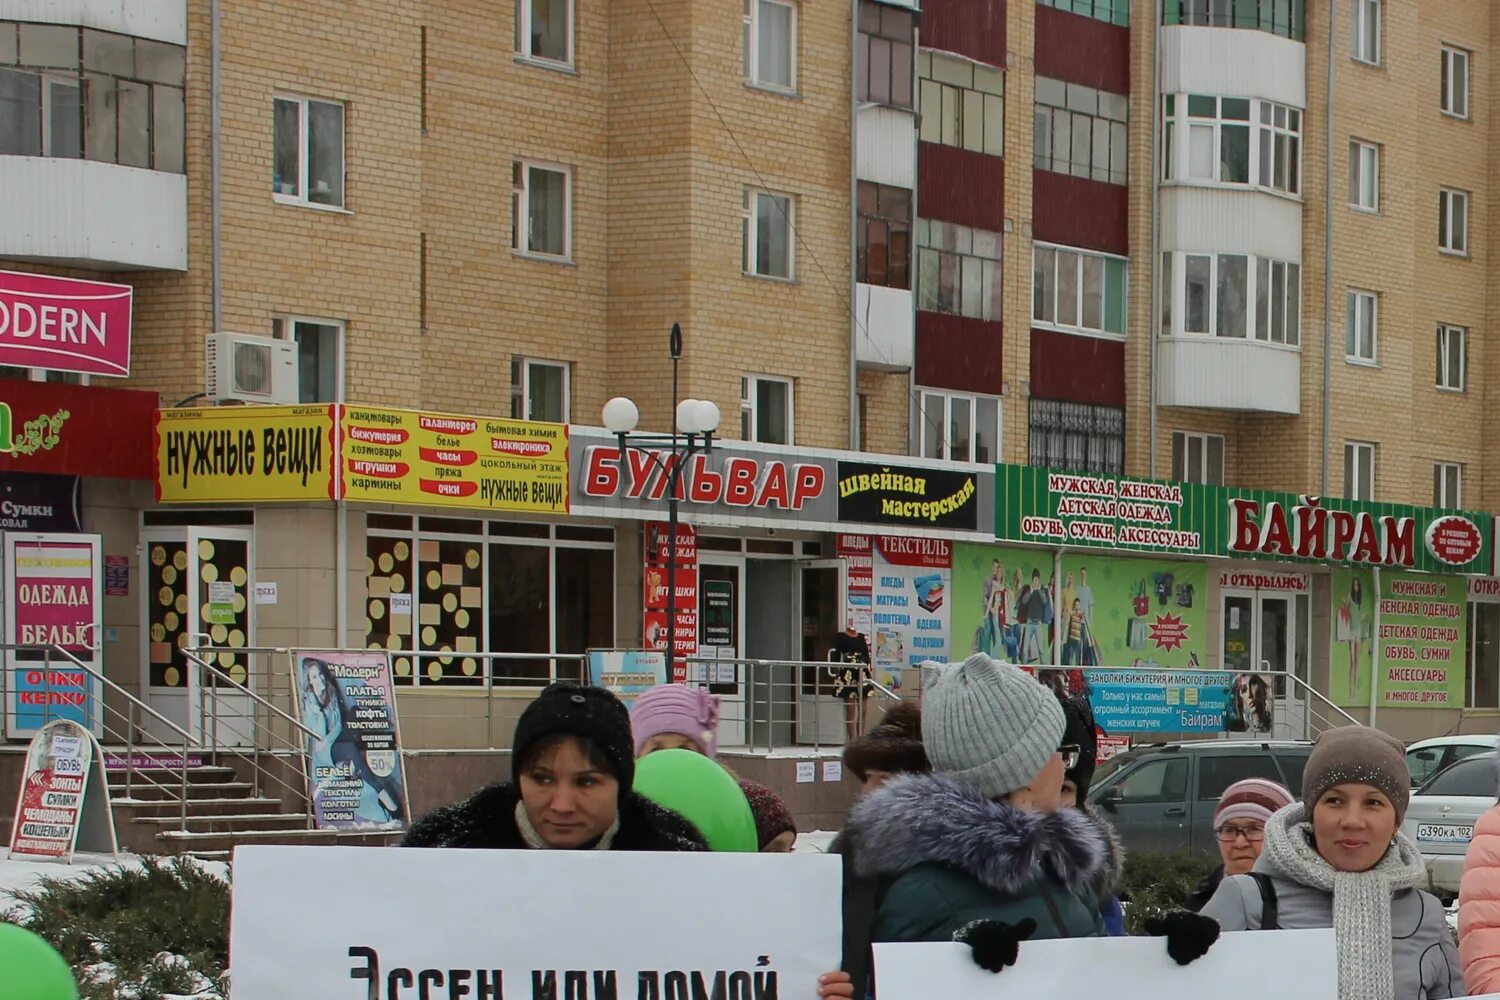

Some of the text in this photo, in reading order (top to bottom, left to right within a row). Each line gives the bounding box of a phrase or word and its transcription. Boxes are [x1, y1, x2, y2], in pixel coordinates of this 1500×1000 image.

[350, 410, 402, 424] канцтовары
[421, 417, 476, 432] галантерея
[486, 423, 557, 438] бытовая химия
[351, 428, 401, 443] бижутерия
[436, 435, 460, 447] белье
[351, 445, 402, 458] хозтовары
[493, 439, 551, 453] электроника
[167, 426, 322, 489] нужные вещи
[436, 452, 461, 462] часы
[355, 462, 397, 474] игрушки
[481, 459, 561, 472] цокольный этаж
[435, 467, 462, 478] пряжа
[582, 445, 825, 511] БУЛЬВАР
[352, 478, 401, 490] картины
[438, 484, 460, 494] очки
[1049, 474, 1183, 505] МУЖСКАЯ, ЖЕНСКАЯ,
[481, 478, 562, 509] нужные вещи
[1059, 498, 1171, 522] ДЕТСКАЯ ОДЕЖДА
[1023, 518, 1199, 548] ОБУВЬ, СУМКИ, АКСЕССУАРЫ
[1228, 495, 1415, 567] БАЙРАМ
[657, 534, 695, 545] МУСКАЯ
[881, 536, 948, 556] ТЕКСТИЛЬ
[20, 585, 89, 605] ОДЕЖДА
[1392, 581, 1446, 596] МУЖСКАЯ И
[1423, 604, 1460, 618] ОДЕЖДА
[677, 615, 695, 624] ЧАСЫ
[22, 622, 88, 645] БЕЛЬЁ
[1421, 627, 1458, 641] ОДЕЖДА
[1421, 649, 1450, 661] СУМКИ
[25, 671, 84, 687] ОЧКИ
[1175, 675, 1202, 684] МНОГОЕ
[1204, 675, 1229, 686] ДРУГОЕ
[1388, 669, 1446, 682] АКСЕССУАРЫ
[346, 686, 384, 695] ПЛАТЬЯ
[1102, 690, 1166, 702] Только у нас самый
[20, 690, 86, 705] КЕПКИ
[1386, 692, 1447, 704] И МНОГОЕ ДРУГОЕ
[1095, 705, 1172, 715] огромный ассортимент
[1107, 719, 1160, 728] женских штучек
[57, 760, 81, 771] ОБУВЬ
[316, 765, 350, 776] БЕЛЬЁ
[50, 777, 81, 789] ЗОНТЫ
[24, 808, 74, 821] ЧЕМОДАНЫ
[23, 824, 70, 836] КОШЕЛЬКИ
